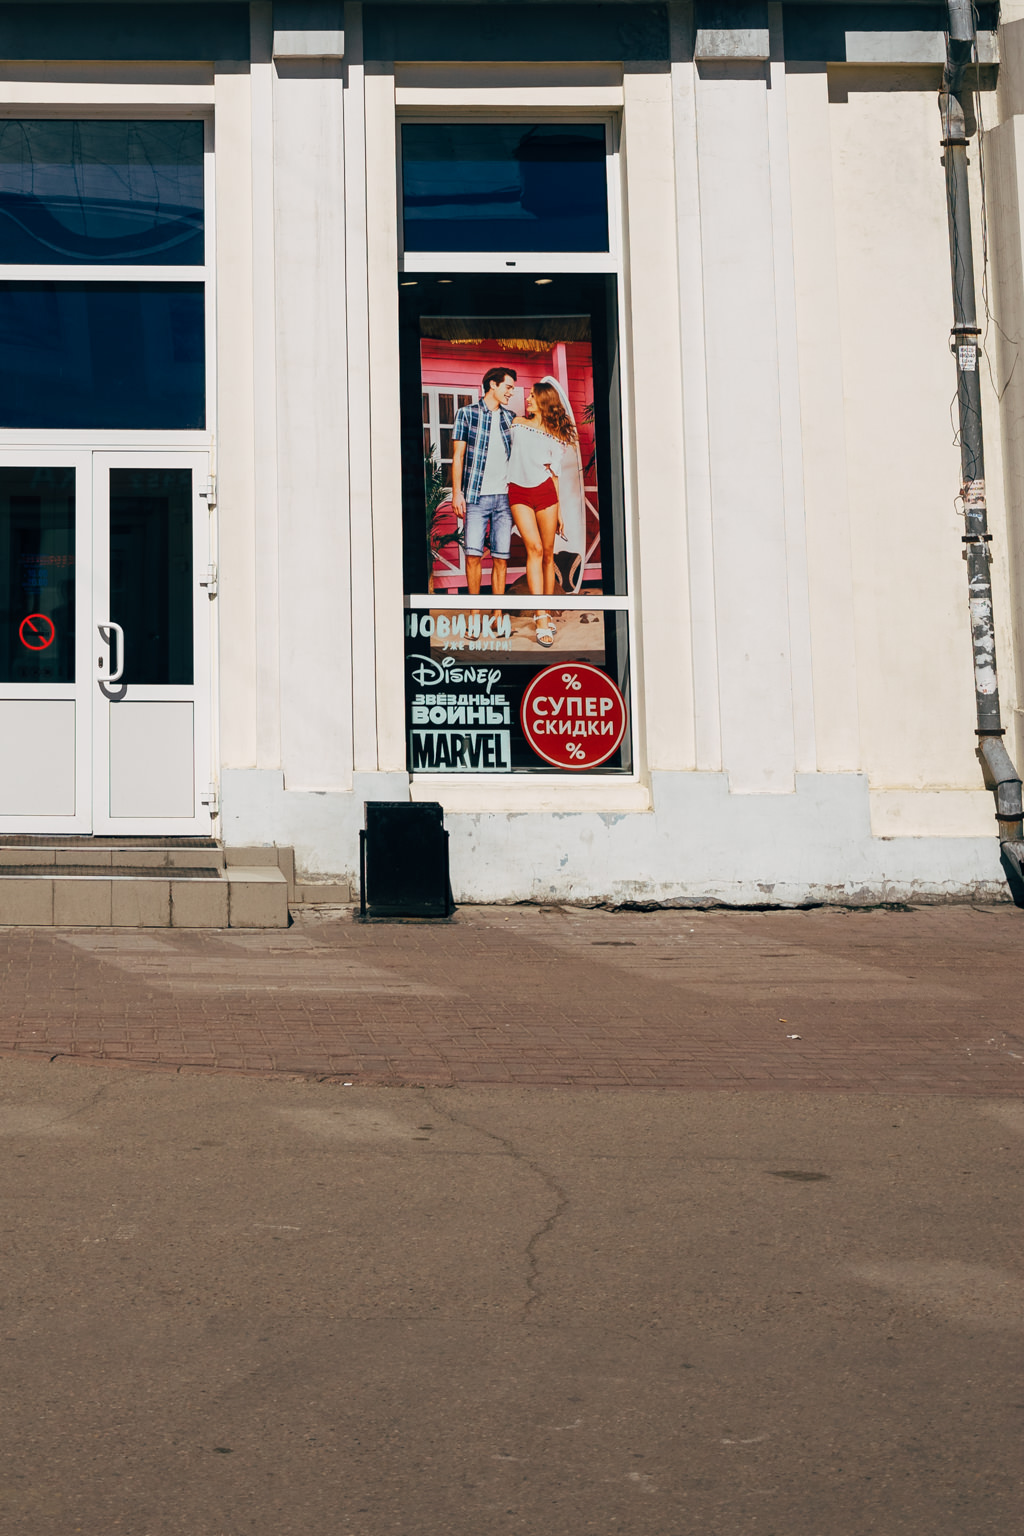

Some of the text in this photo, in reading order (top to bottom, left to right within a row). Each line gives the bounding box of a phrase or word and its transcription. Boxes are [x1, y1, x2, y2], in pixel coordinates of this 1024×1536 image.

[405, 612, 512, 639] НОВИНКИ
[442, 640, 465, 651] УЖЕ
[411, 692, 510, 706] ЗВЁЗДНЫЕ
[532, 696, 614, 717] СУПЕР
[411, 706, 511, 725] ВОЙНЫ
[532, 720, 614, 738] СКИДКИ
[412, 732, 508, 769] MARVEL
